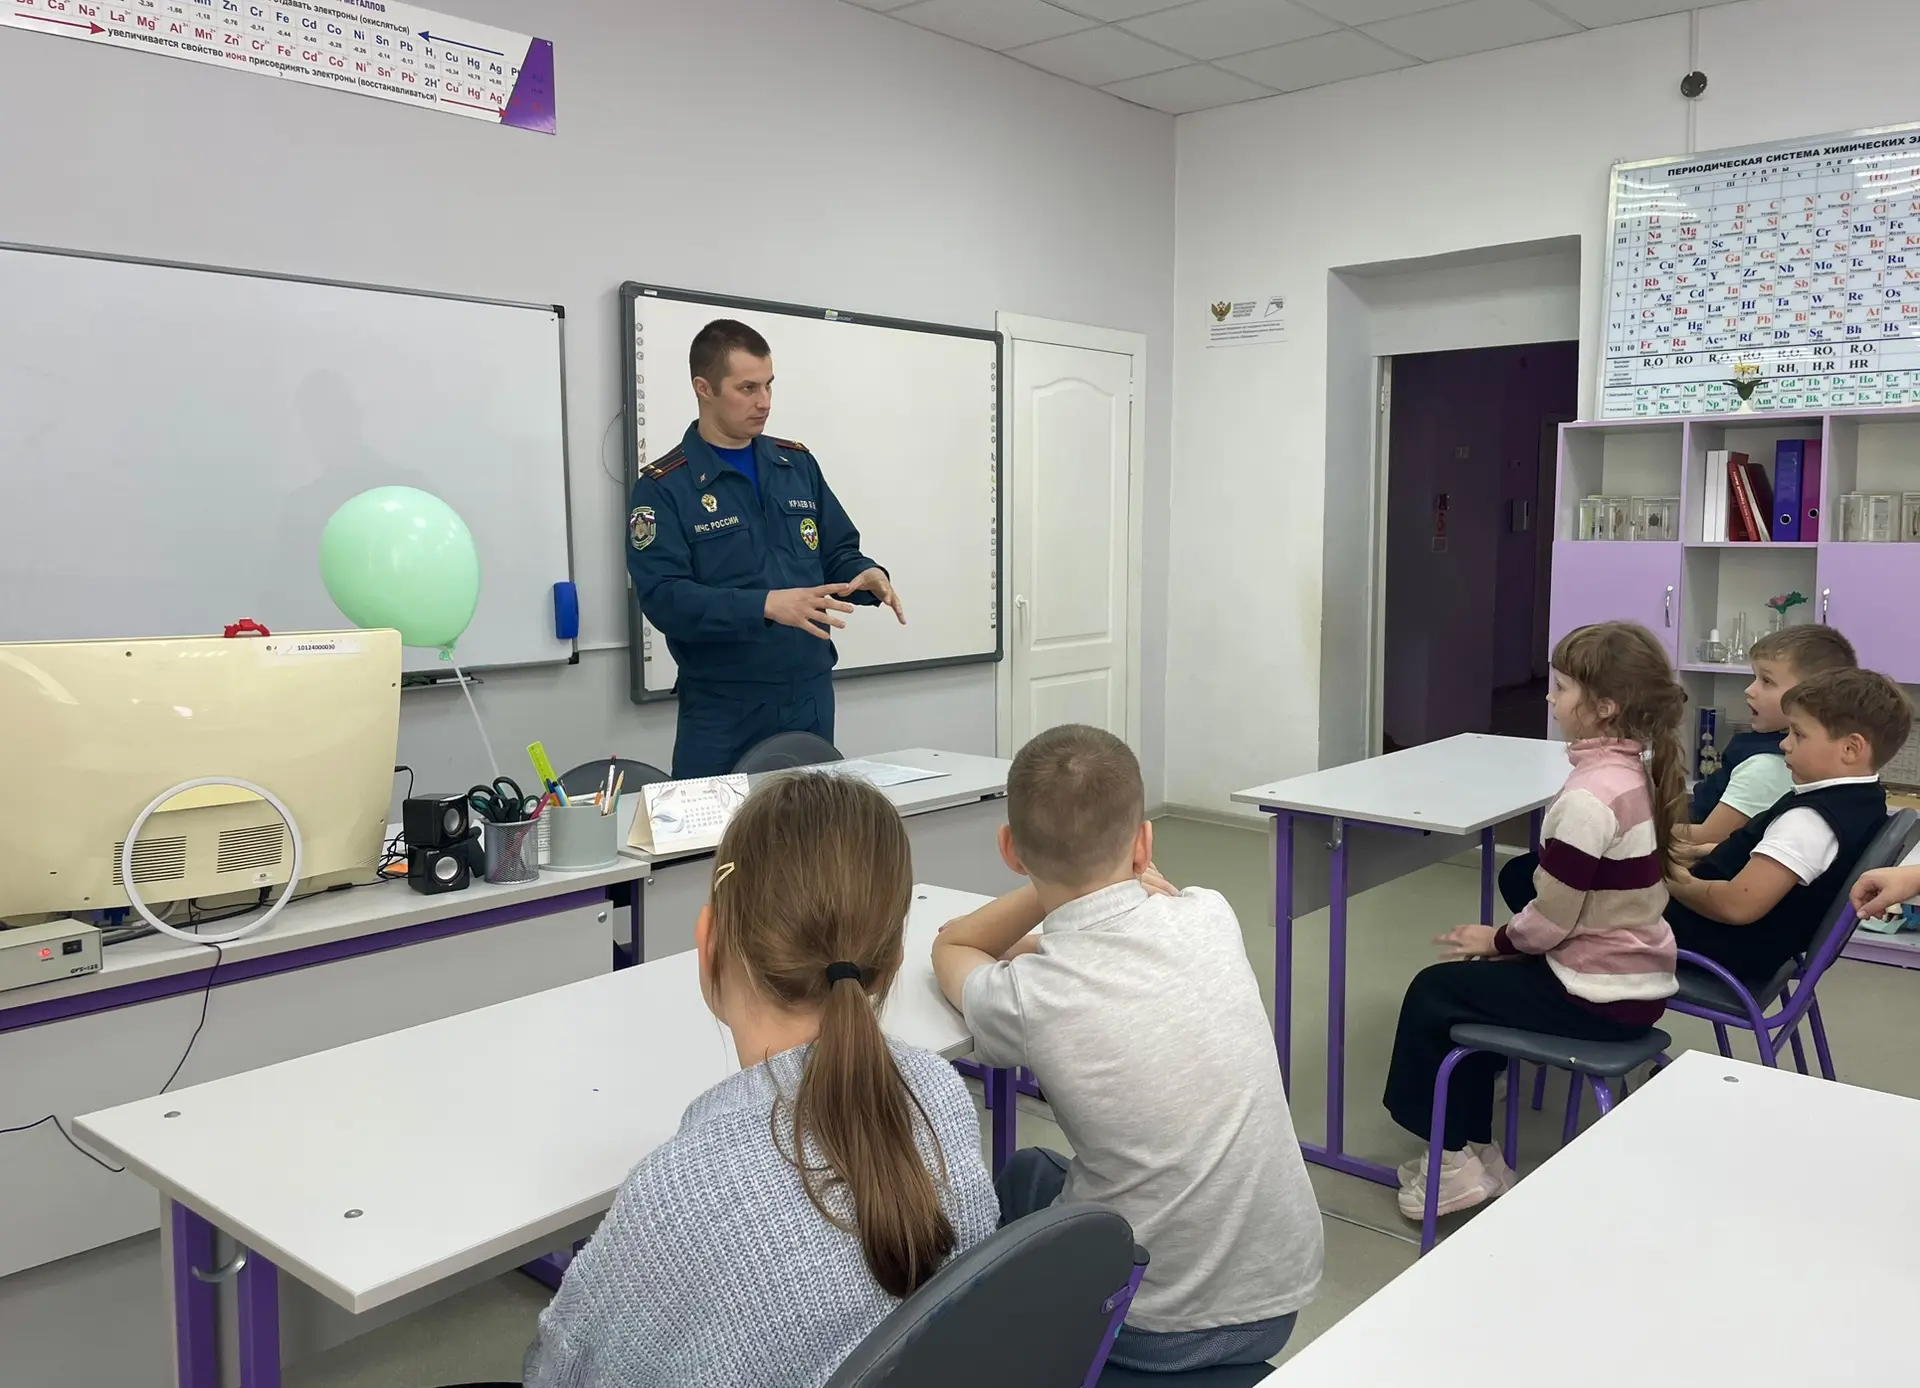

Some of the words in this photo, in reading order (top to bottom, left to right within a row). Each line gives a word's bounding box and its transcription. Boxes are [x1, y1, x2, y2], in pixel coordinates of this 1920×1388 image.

[314, 5, 358, 20] электроны
[360, 15, 410, 36] (окисляться)
[223, 0, 238, 12] Zn
[250, 6, 263, 17] Cr
[276, 12, 290, 23] Fe
[302, 18, 317, 30] Cd
[327, 24, 342, 34] Co
[354, 30, 365, 40] Ni
[376, 34, 390, 46] Sn
[400, 40, 414, 52] Pb
[446, 52, 458, 62] Cu
[468, 57, 480, 70] Hg
[490, 63, 502, 74] Ag
[108, 28, 178, 48] увеличивается
[182, 42, 223, 57] свойство
[226, 52, 246, 62] иона
[249, 56, 310, 74] присоединять
[312, 69, 356, 84] электроны
[358, 77, 438, 103] (восстанавливаться)
[1668, 156, 1762, 176] ПЕРИОДИЧЕСКАЯ
[1766, 149, 1820, 163] СИСТЕМА
[1824, 137, 1906, 156] ХИМИЧЕСКИХ
[1736, 204, 1744, 214] B
[1770, 201, 1777, 209] C
[1805, 197, 1814, 206] N
[1840, 192, 1850, 201] O
[1648, 231, 1662, 239] Na
[1680, 227, 1696, 236] Mg
[1731, 221, 1743, 230] Al
[1768, 216, 1778, 226] Si
[1806, 212, 1813, 222] P
[1842, 208, 1848, 217] S
[1647, 247, 1655, 256] K
[1679, 243, 1693, 252] Ca
[1712, 240, 1724, 248] Sc
[1746, 236, 1757, 244] Ti
[1780, 232, 1789, 240] V
[1816, 228, 1831, 237] Cr
[1852, 224, 1872, 232] Mn
[1890, 220, 1904, 230] Fe
[1660, 261, 1674, 270] Cu
[1692, 257, 1706, 266] Zn
[1725, 253, 1740, 262] Ga
[1760, 250, 1776, 260] Ge
[1834, 243, 1846, 252] Se
[1870, 240, 1884, 248] Br
[1644, 278, 1660, 287] Rb
[1676, 275, 1688, 284] Sr
[1710, 272, 1718, 280] Y
[1744, 268, 1757, 277] Zr
[1780, 264, 1794, 274] Nb
[1815, 262, 1832, 270] Mo
[1851, 258, 1864, 266] Tc
[1888, 255, 1904, 264] Ru
[1658, 293, 1672, 302] Ag
[1690, 289, 1704, 298] Cd
[1728, 286, 1738, 294] In
[1760, 283, 1772, 292] Sn
[1795, 280, 1808, 288] Sb
[1832, 276, 1845, 285] Te
[1642, 310, 1655, 318] Cs
[1674, 306, 1688, 316] Ba
[1742, 300, 1756, 310] Hf
[1777, 297, 1790, 306] Ta
[1812, 295, 1824, 303] W
[1848, 292, 1864, 300] Re
[1886, 289, 1900, 298] Os
[1688, 322, 1702, 331] Hg
[1756, 316, 1771, 324] Pb
[1795, 312, 1806, 322] Bi
[1829, 310, 1842, 319] Po
[1902, 304, 1918, 314] Rn
[1673, 338, 1686, 346] Ra
[1740, 332, 1752, 342] Rf
[1774, 330, 1790, 339] Db
[1809, 328, 1823, 338] Sg
[1846, 326, 1862, 334] Bh
[1884, 323, 1898, 332] Hs
[1676, 356, 1693, 364] RO
[1850, 360, 1868, 368] HR
[1808, 378, 1820, 386] Tb
[1832, 377, 1846, 386] Dy
[1806, 394, 1818, 402] Bk
[1858, 392, 1870, 400] Es
[1886, 391, 1901, 400] Fm
[694, 524, 710, 532] МЧС
[710, 516, 739, 530] РОССИИ
